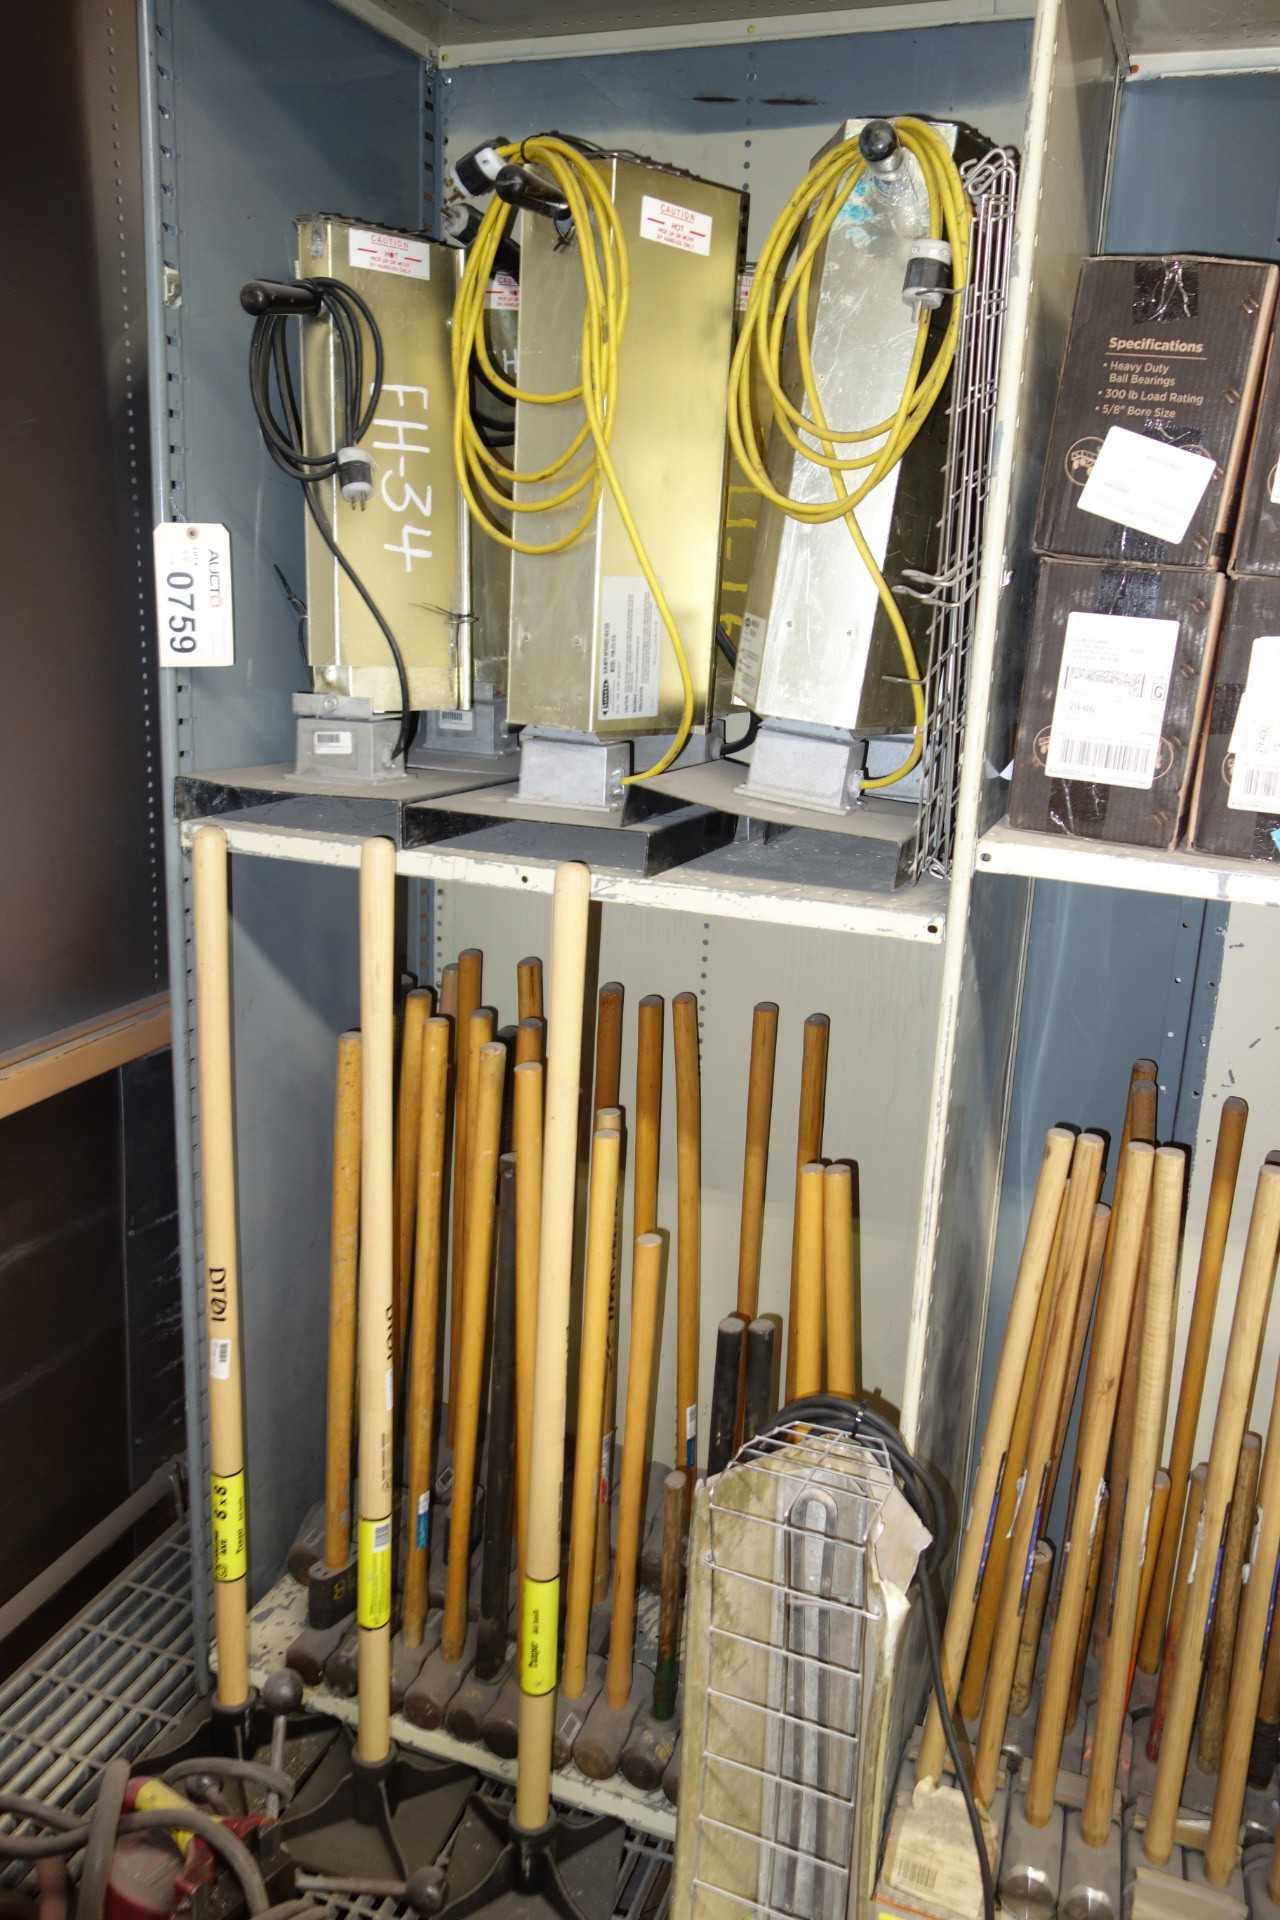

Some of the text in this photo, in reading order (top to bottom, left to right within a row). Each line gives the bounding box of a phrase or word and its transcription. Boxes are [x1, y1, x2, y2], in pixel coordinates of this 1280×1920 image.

[1108, 337, 1204, 353] Specifications
[1110, 361, 1169, 375] Heavy Duty
[1108, 372, 1176, 387] Ball Bearings
[1104, 388, 1204, 406] 300 lb Load Rating
[1127, 406, 1152, 417] Bore
[1153, 407, 1177, 418] Size
[370, 382, 432, 573] FH-34
[208, 549, 223, 608] AUCTO
[167, 572, 197, 654] 0759
